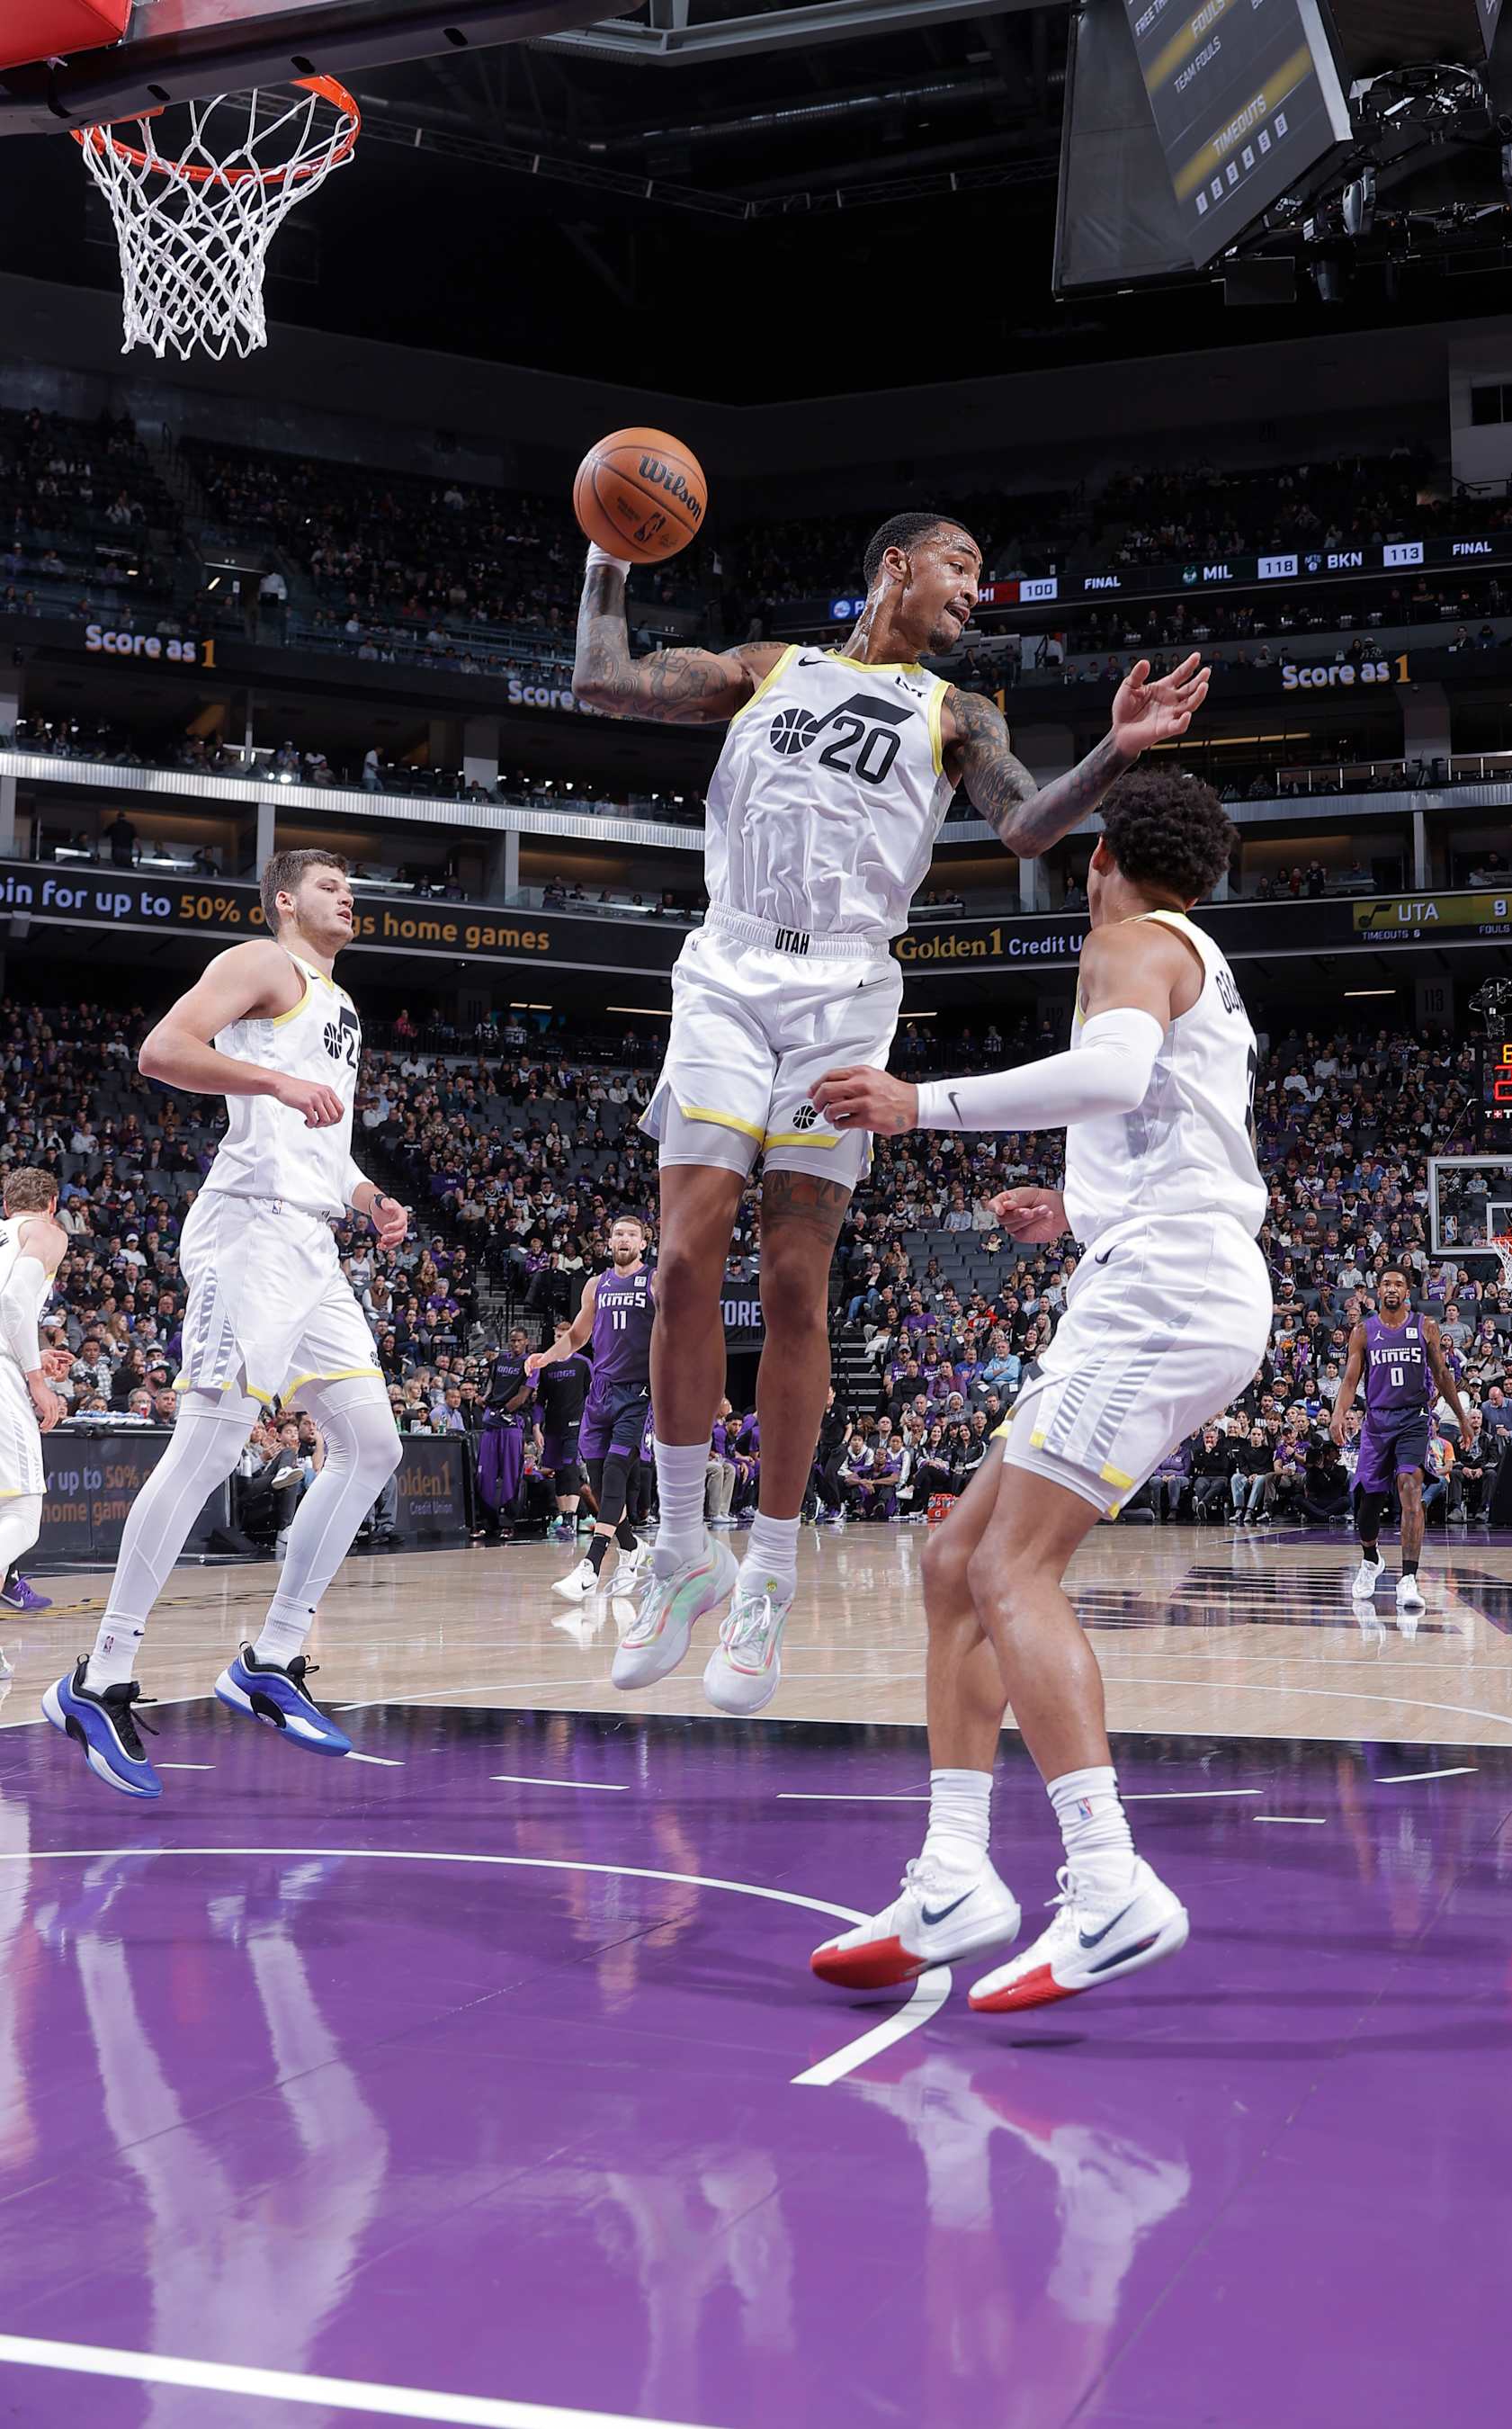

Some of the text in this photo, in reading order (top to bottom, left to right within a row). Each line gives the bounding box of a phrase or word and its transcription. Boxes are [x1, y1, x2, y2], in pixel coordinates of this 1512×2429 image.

[1134, 7, 1155, 36] FREE
[1192, 0, 1225, 38] FOULS
[1174, 35, 1221, 94] TEAM FOULS
[1212, 94, 1267, 157] TIMEOUTS
[639, 454, 702, 523] Wilson
[979, 591, 994, 603] HI
[1026, 582, 1052, 596] 100
[1084, 576, 1121, 590] FINAL
[1203, 566, 1233, 580] MIL
[1265, 560, 1293, 575] 118
[1327, 552, 1363, 569] BKN
[1391, 546, 1419, 560] 113
[1453, 542, 1492, 555] FINAL
[85, 624, 217, 668] Score as 1
[1282, 653, 1411, 690] Score as 1
[508, 680, 575, 711] Score
[819, 716, 901, 784] 20
[0, 877, 32, 904] in
[42, 880, 87, 909] for
[96, 892, 132, 918] up
[140, 892, 172, 916] to
[180, 895, 240, 923] 50%
[352, 916, 376, 937] gs
[384, 912, 458, 942] home
[465, 925, 550, 950] games
[1398, 902, 1439, 922] UTA
[775, 928, 810, 955] UTAH
[1008, 937, 1066, 956] Credit
[1362, 929, 1409, 940] TIMEOUTS
[1480, 924, 1511, 935] FOULS
[1425, 989, 1444, 1012] 113
[343, 1027, 361, 1070] 2
[612, 1310, 627, 1330] 11
[1391, 1367, 1404, 1386] 0
[58, 1471, 80, 1496] up
[83, 1465, 102, 1491] to
[104, 1465, 139, 1490] 50%
[398, 1461, 452, 1497] olden1
[93, 1500, 131, 1527] gam
